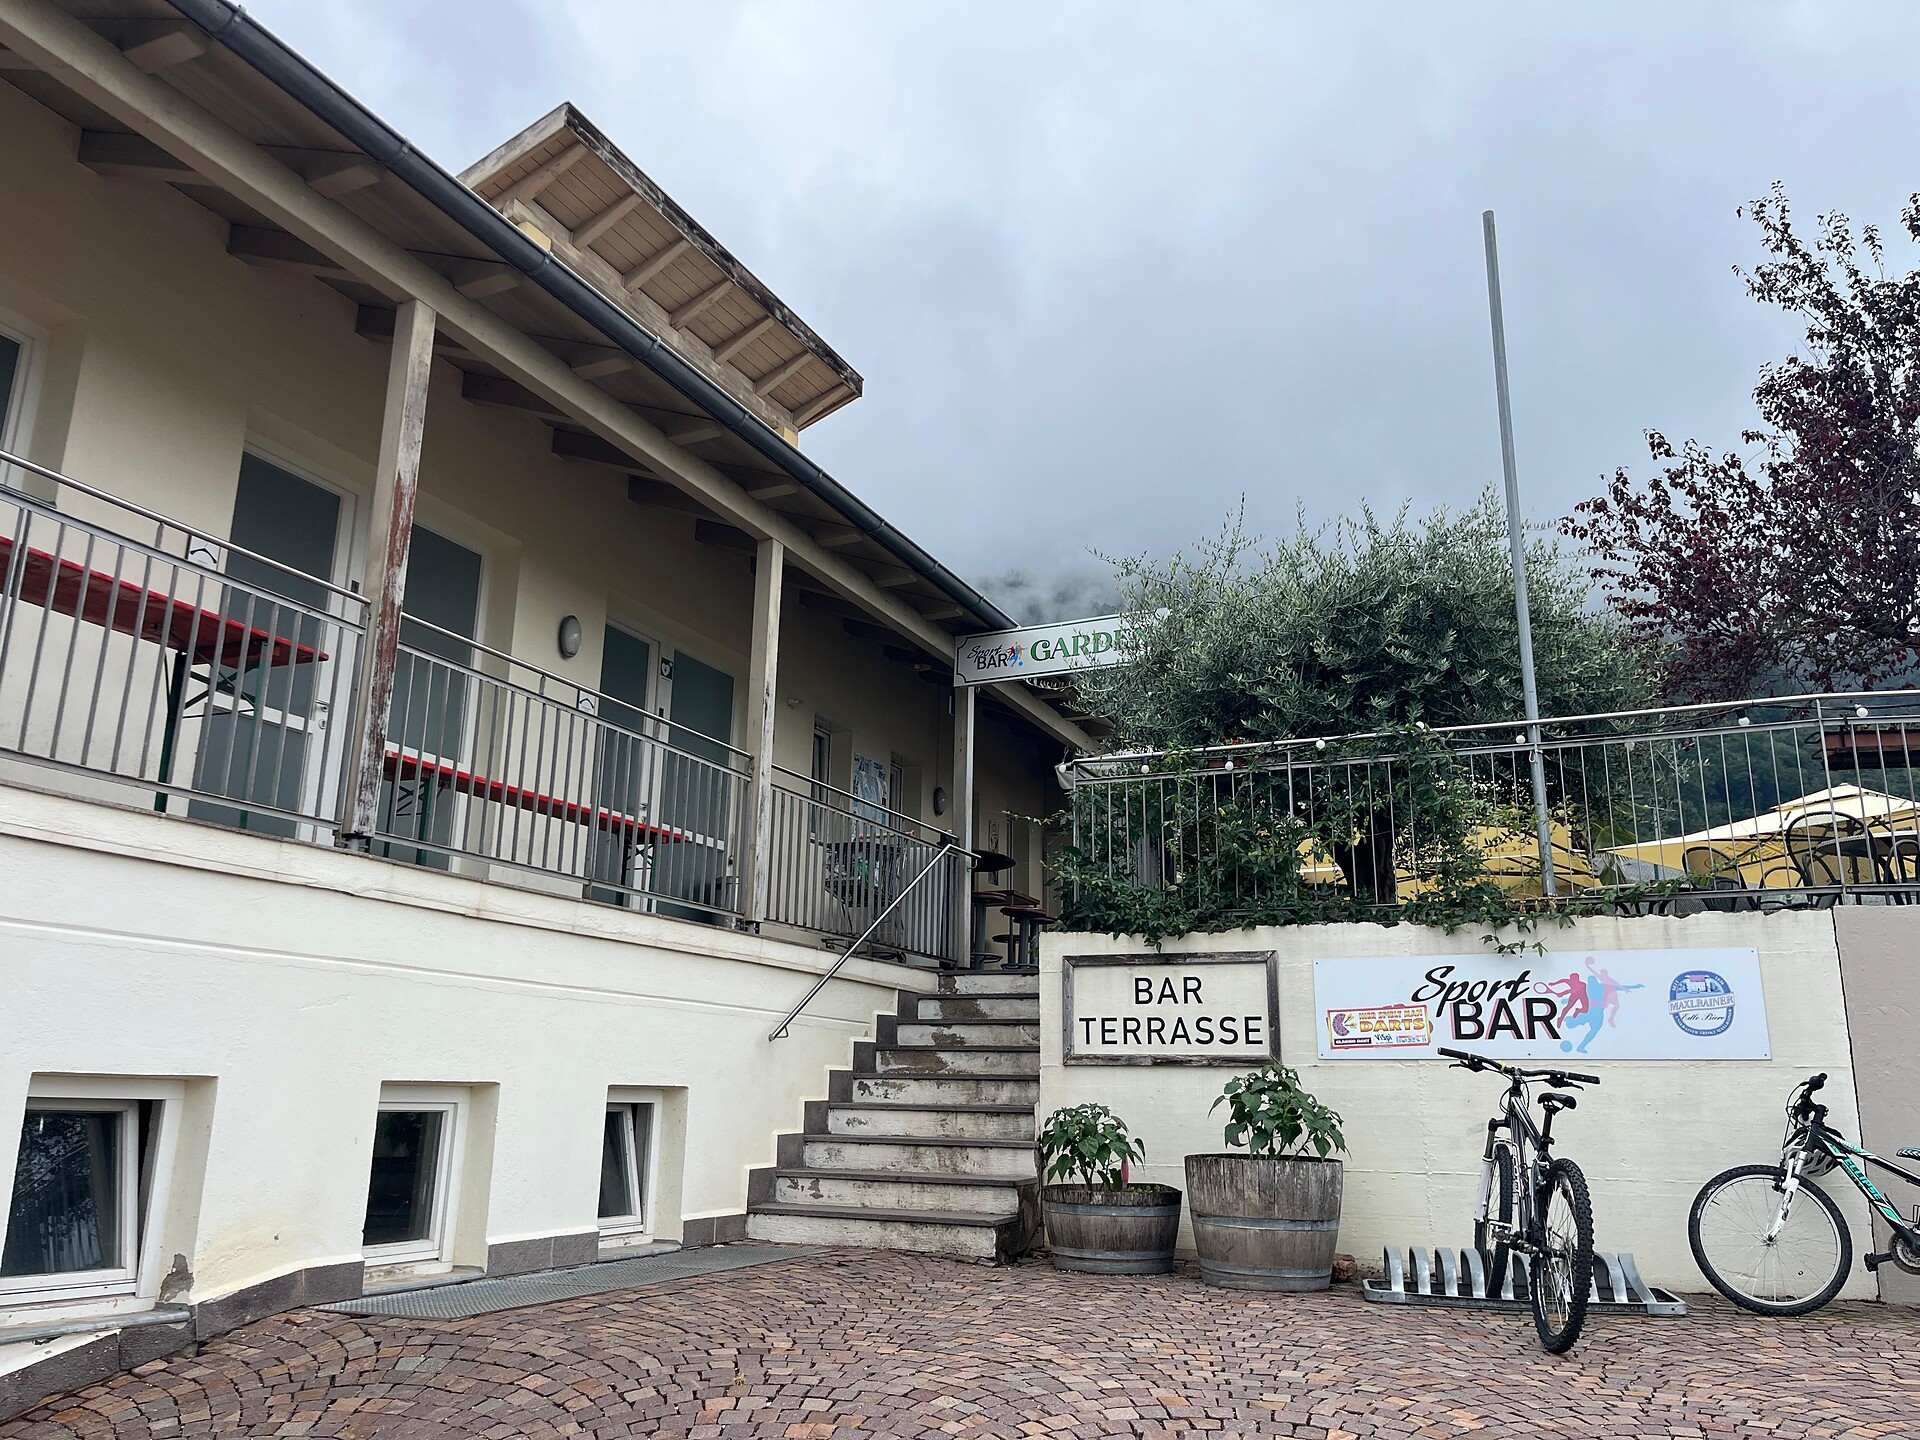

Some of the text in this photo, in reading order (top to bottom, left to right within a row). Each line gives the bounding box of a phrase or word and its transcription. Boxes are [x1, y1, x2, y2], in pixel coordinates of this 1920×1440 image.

[967, 645, 1002, 664] Sport
[976, 653, 1008, 670] BAR
[1134, 977, 1203, 1005] BAR
[1411, 965, 1532, 1018] Sport
[1670, 995, 1734, 1011] MAXLRAINER
[1078, 1016, 1264, 1045] TERRASSE
[1359, 1018, 1425, 1033] DARTS
[1452, 997, 1562, 1040] BAR
[1844, 1158, 1882, 1200] ELLIPSE
